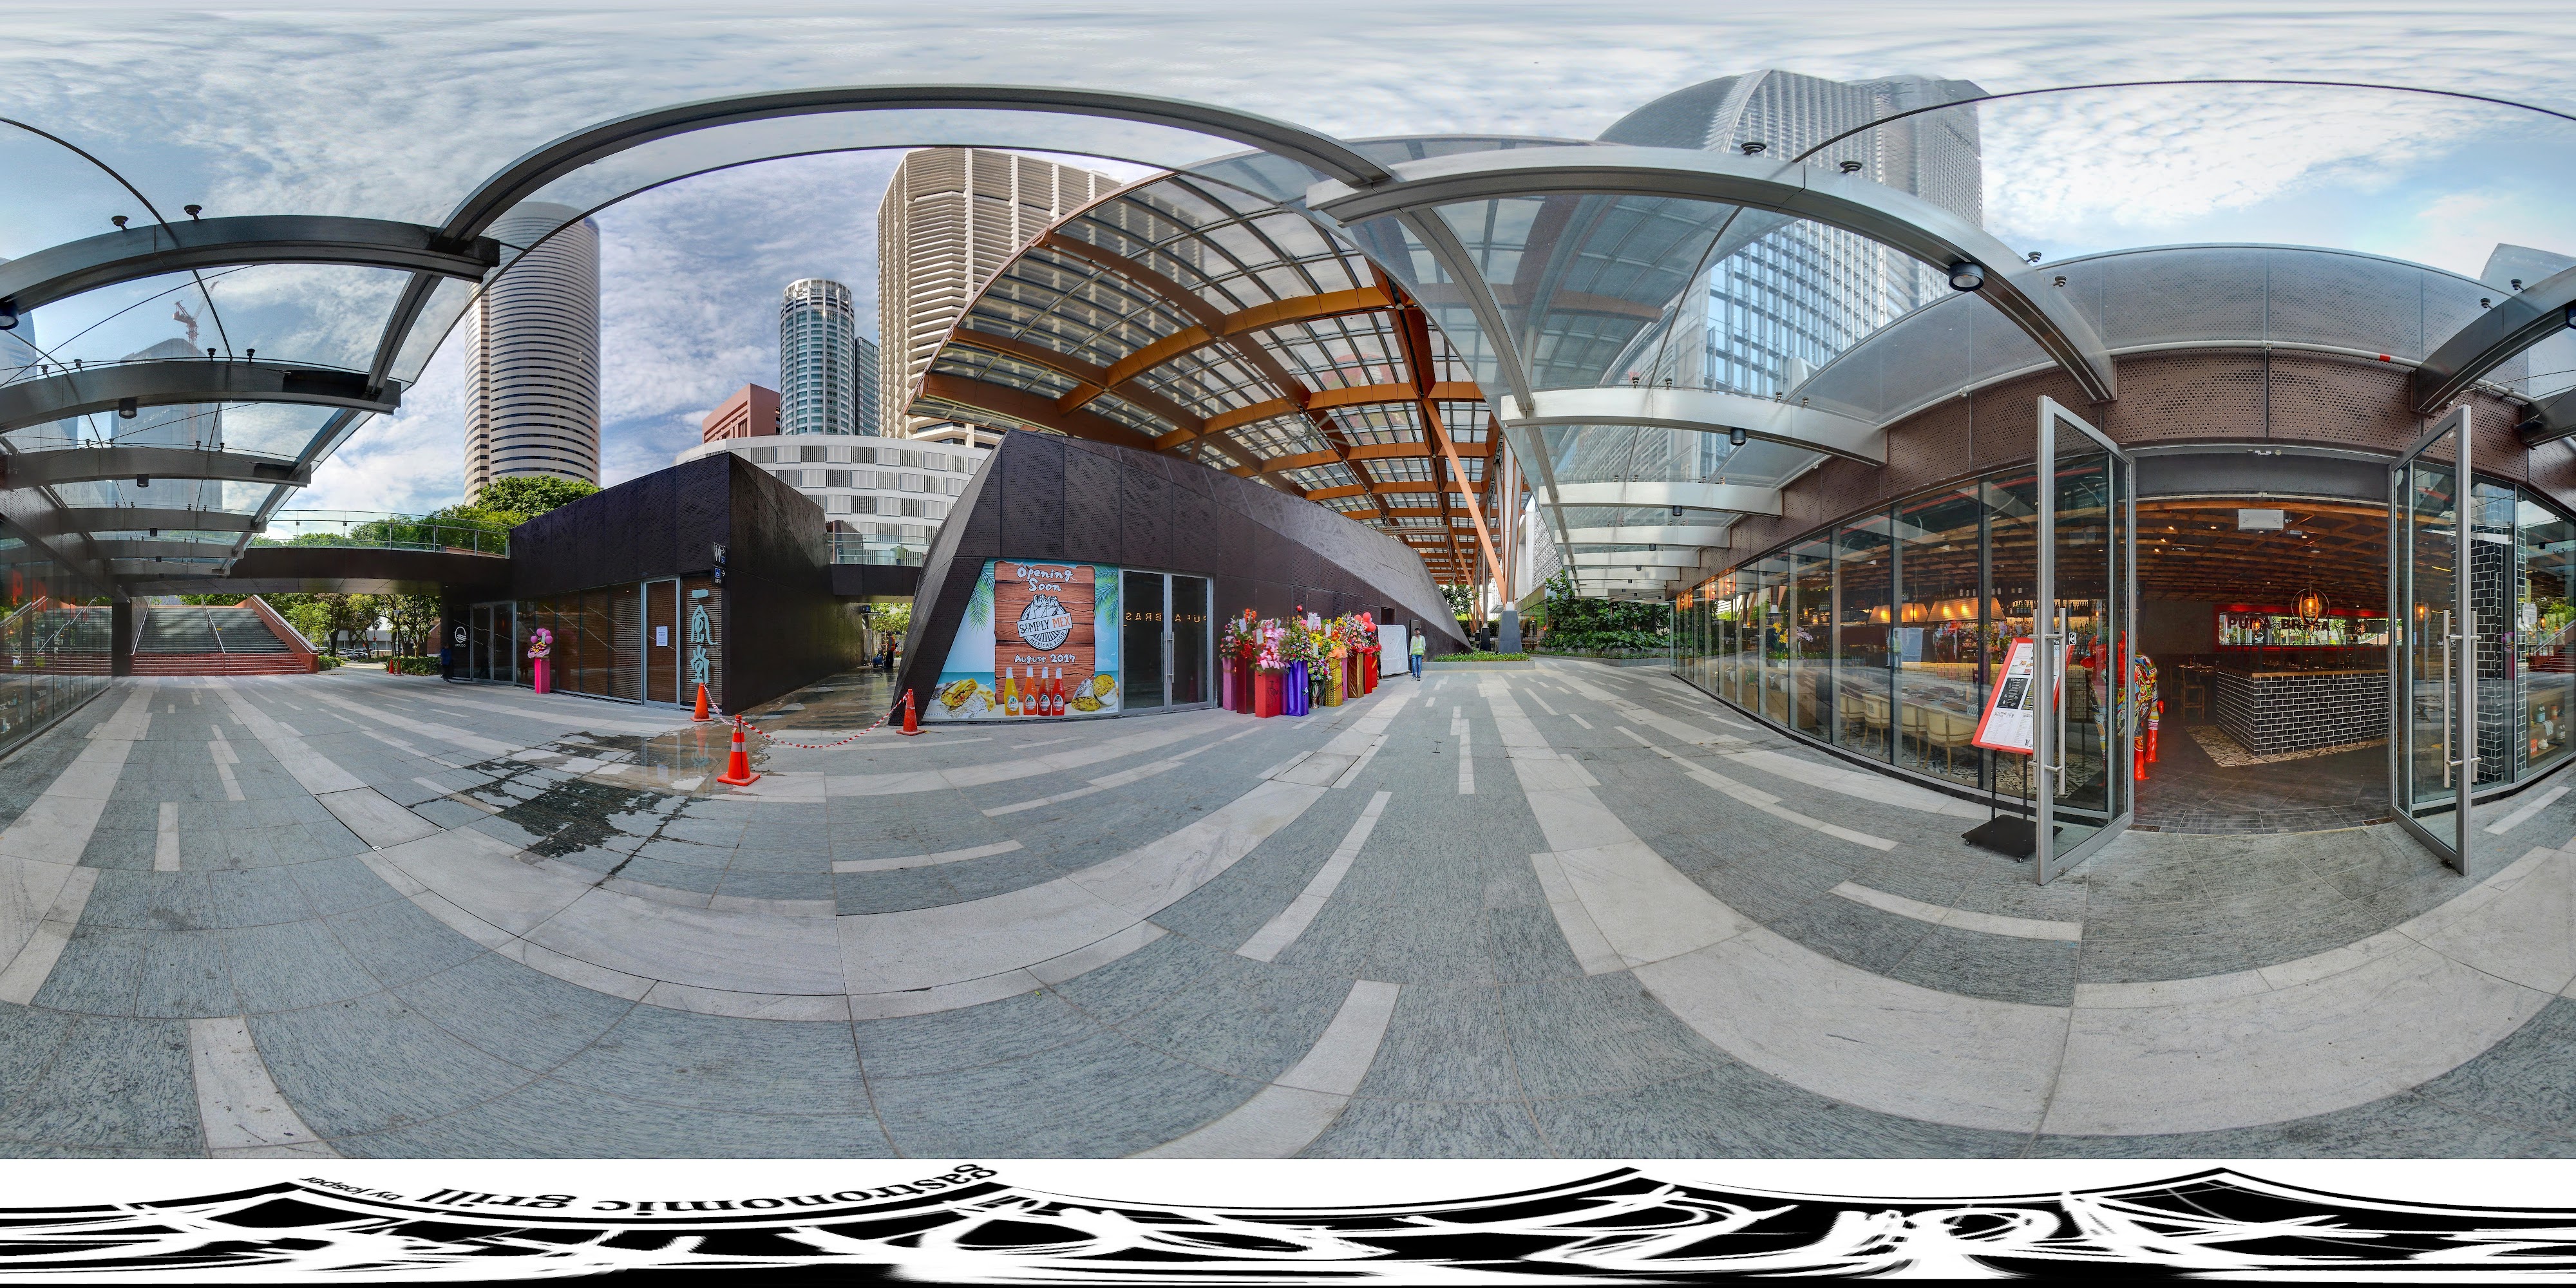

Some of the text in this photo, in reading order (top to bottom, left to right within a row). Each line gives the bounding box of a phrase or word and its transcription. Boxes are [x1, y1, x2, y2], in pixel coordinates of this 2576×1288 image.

[1017, 567, 1074, 582] Opening
[1028, 578, 1062, 592] Soon
[1019, 616, 1071, 634] SIMPLY MEX
[1030, 632, 1065, 648] MEXICAN FOOD
[1014, 654, 1076, 664] August 2017
